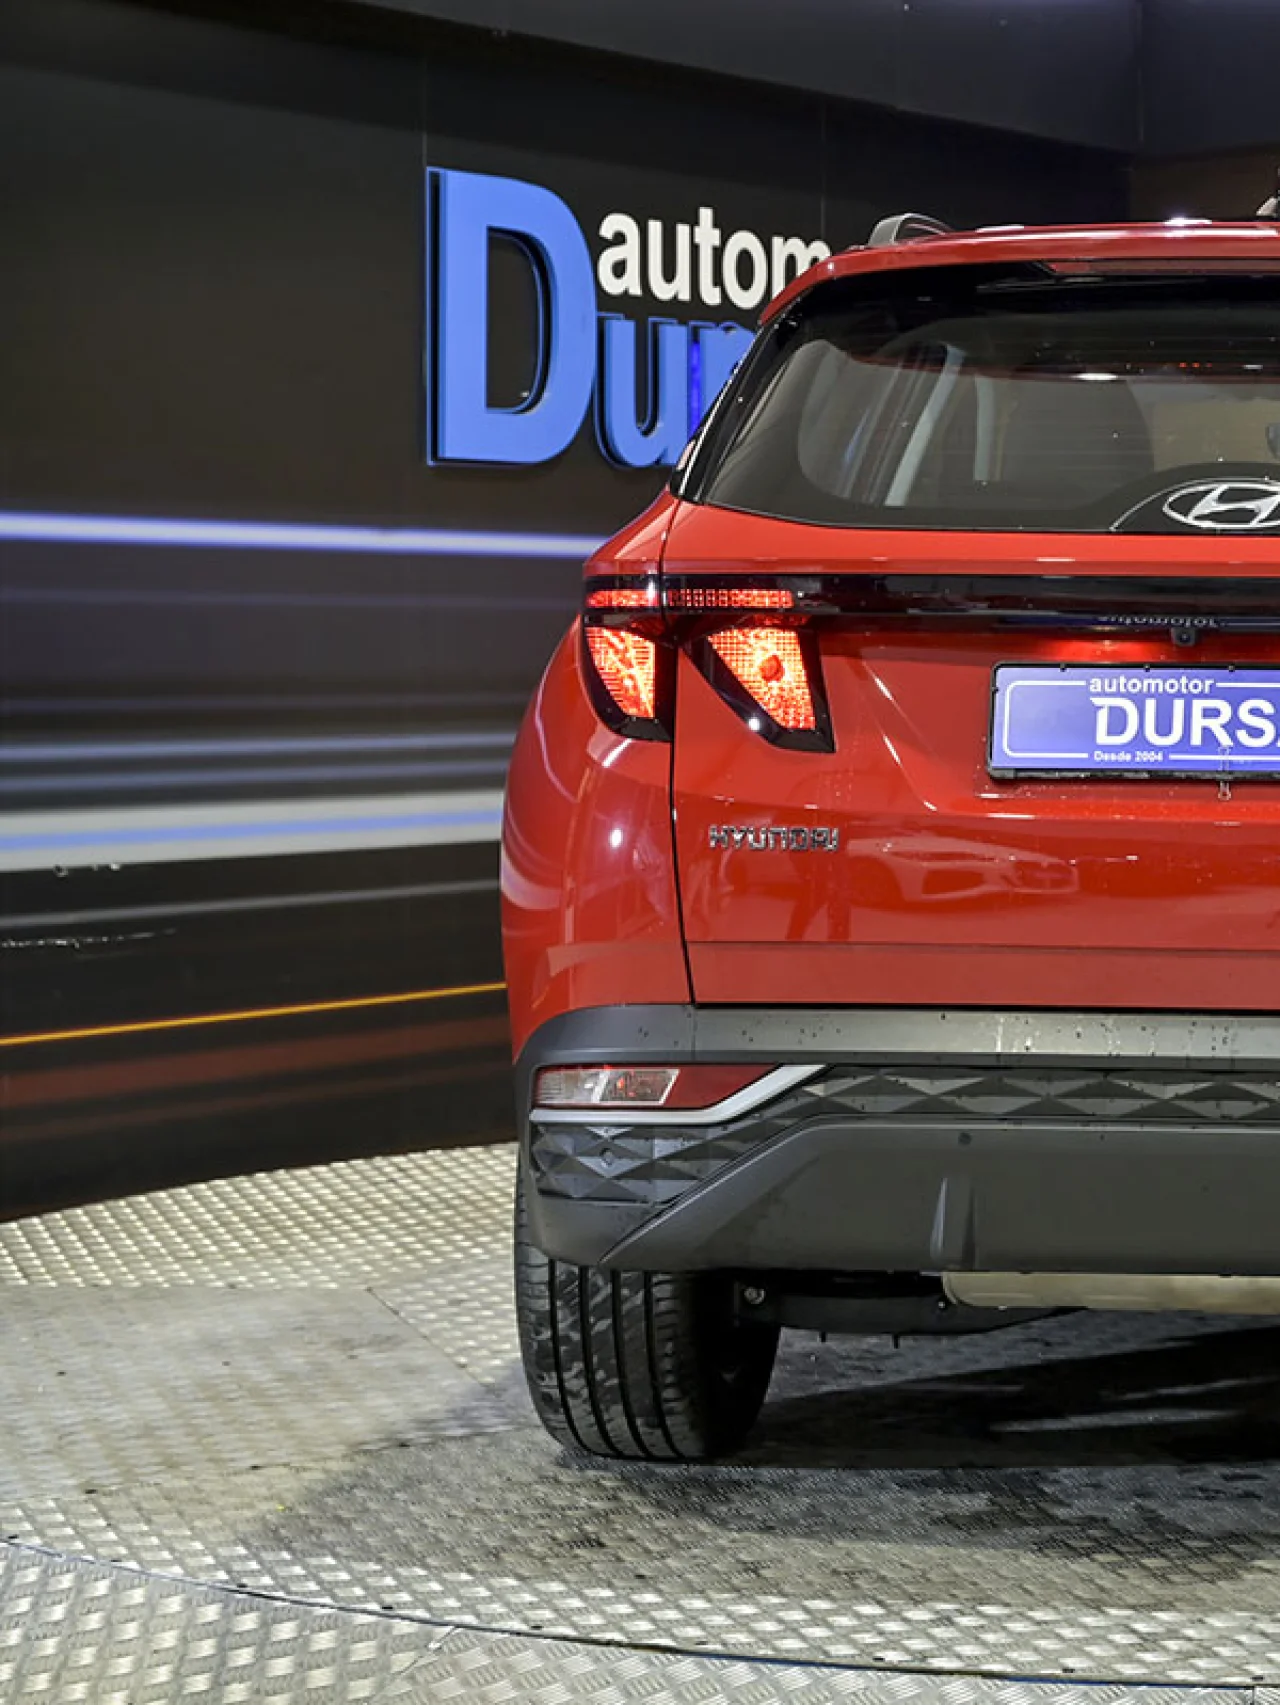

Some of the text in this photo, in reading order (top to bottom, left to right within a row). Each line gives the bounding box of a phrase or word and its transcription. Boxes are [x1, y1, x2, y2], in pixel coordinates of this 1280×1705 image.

[1089, 675, 1215, 694] automotor
[1094, 750, 1164, 762] Desde 2004
[708, 823, 840, 850] HYUNDAI
